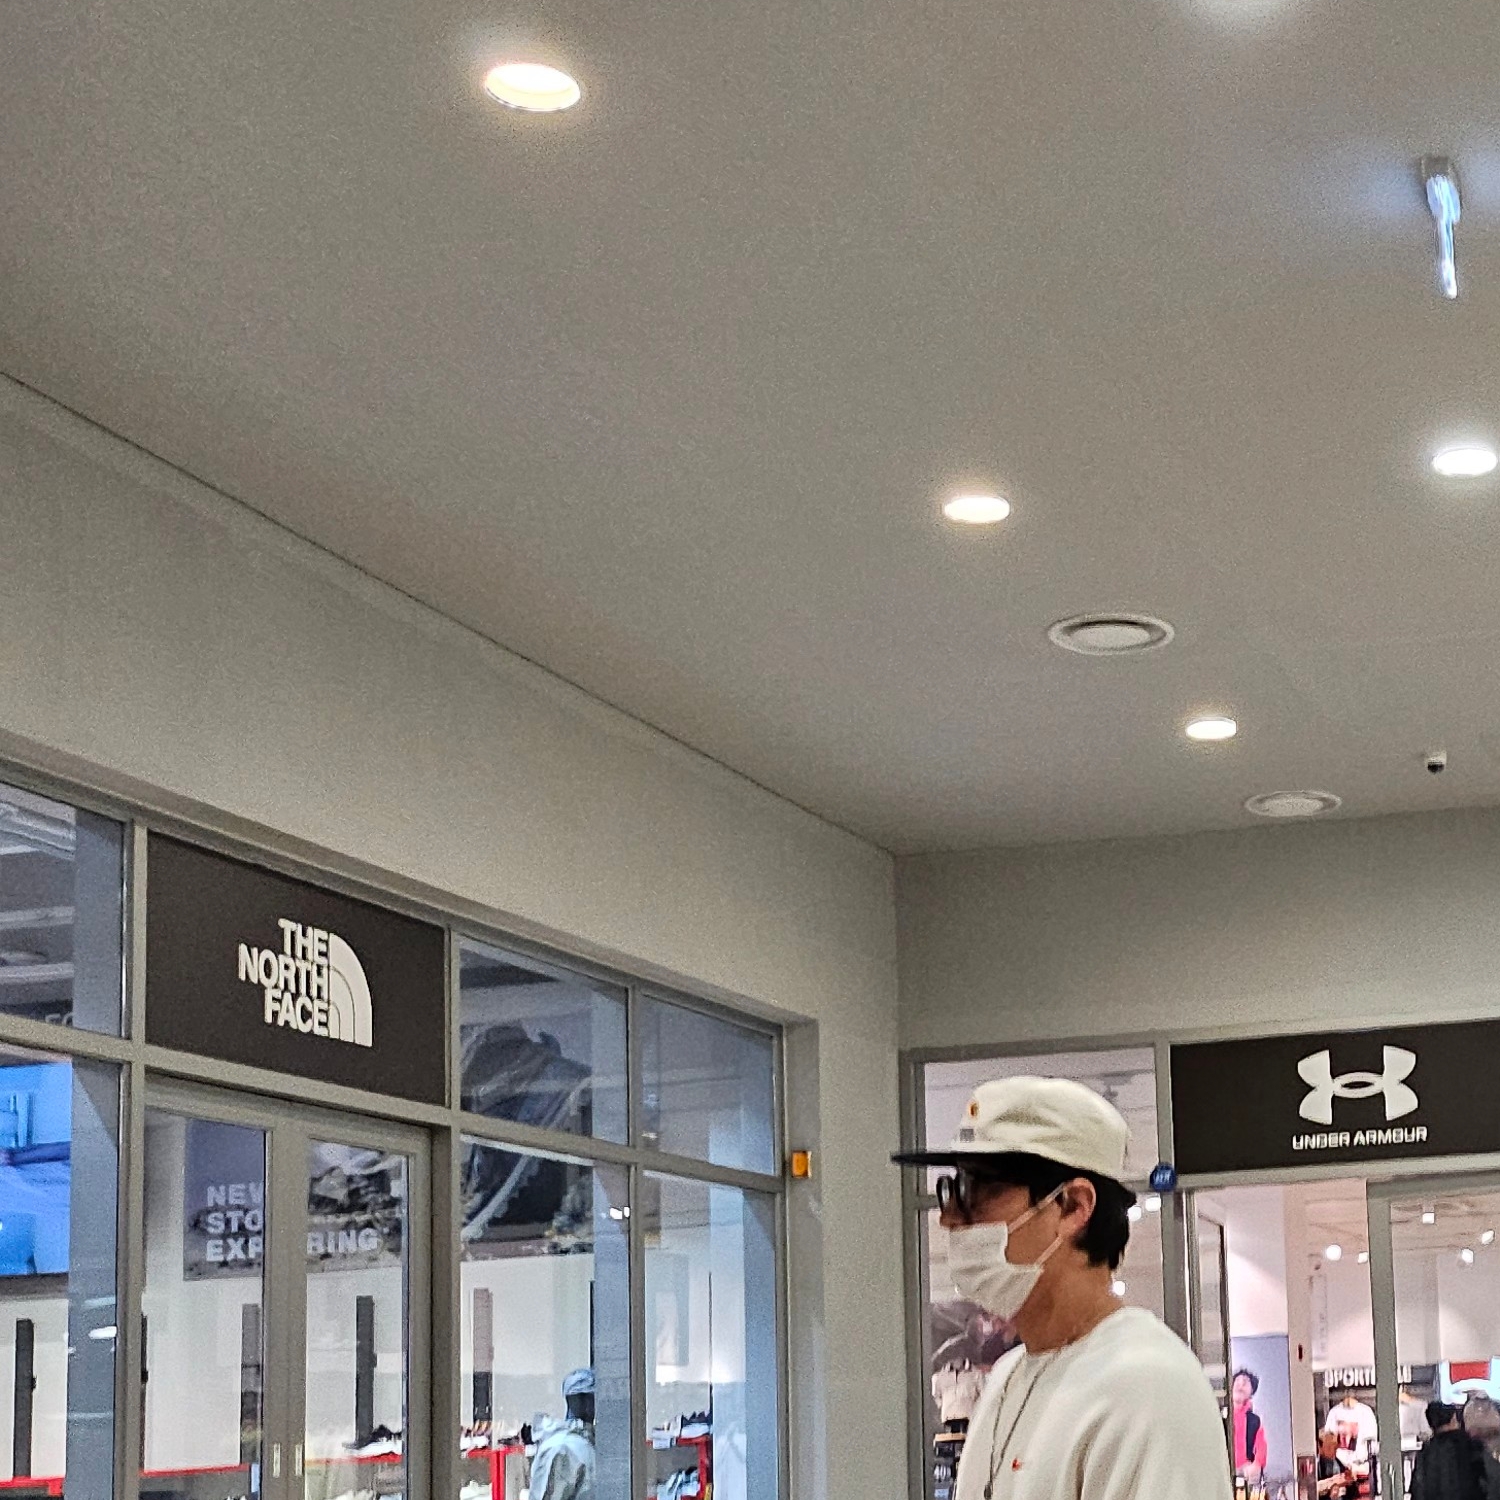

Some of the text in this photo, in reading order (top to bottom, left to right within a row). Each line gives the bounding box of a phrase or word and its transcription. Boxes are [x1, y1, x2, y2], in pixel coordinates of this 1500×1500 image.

[278, 918, 328, 967] THE
[238, 943, 328, 1001] NORTH
[264, 987, 329, 1037] FACE
[1292, 1126, 1428, 1150] UNDER ARMOUR
